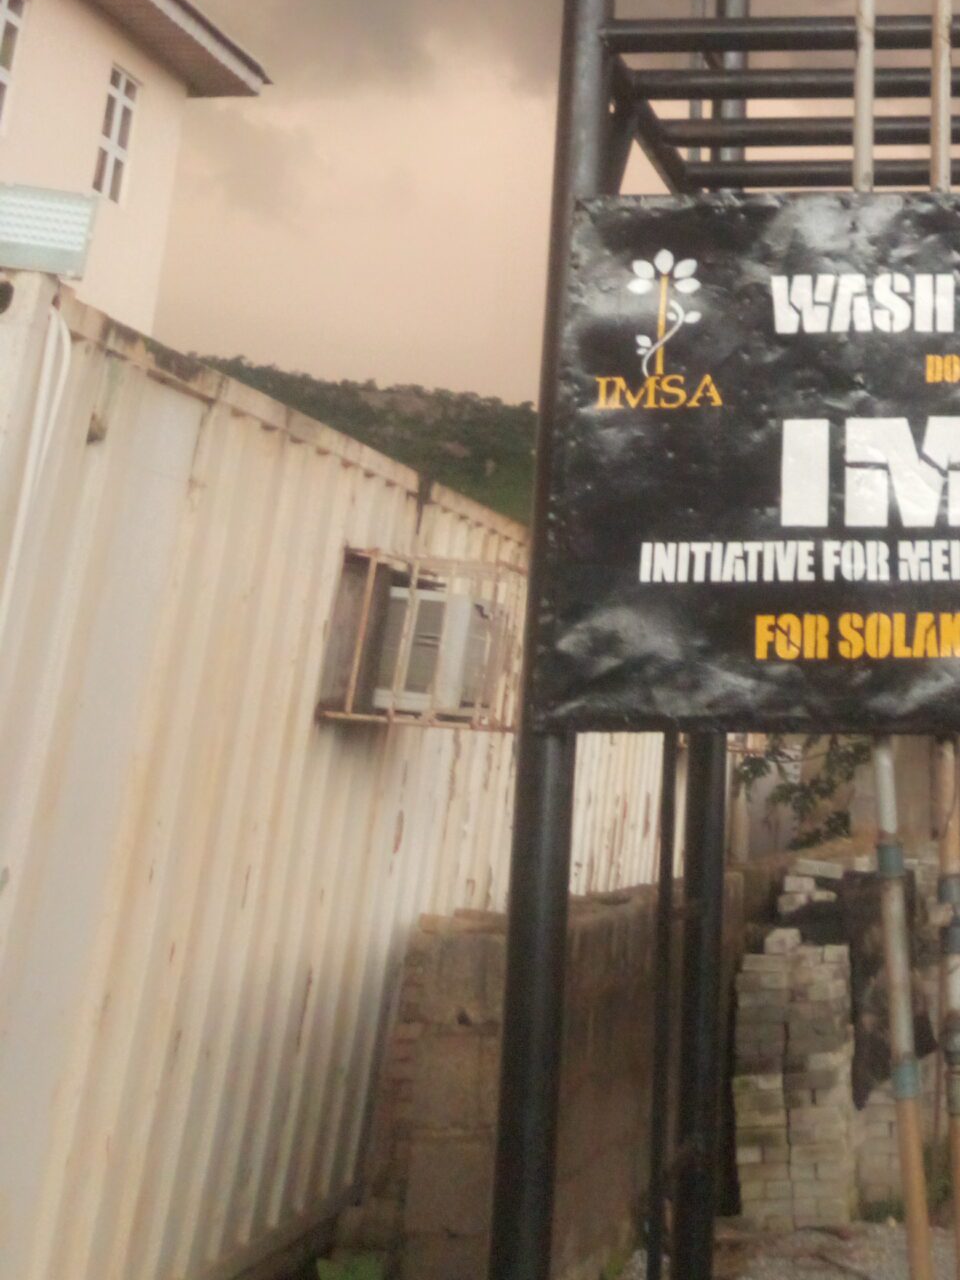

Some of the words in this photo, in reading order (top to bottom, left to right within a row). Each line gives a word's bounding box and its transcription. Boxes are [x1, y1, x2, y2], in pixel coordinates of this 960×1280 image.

[770, 273, 956, 335] WASH
[595, 373, 723, 410] IMSA
[639, 540, 816, 583] INITIATIVE
[822, 539, 890, 582] FOR
[755, 613, 829, 661] FOR
